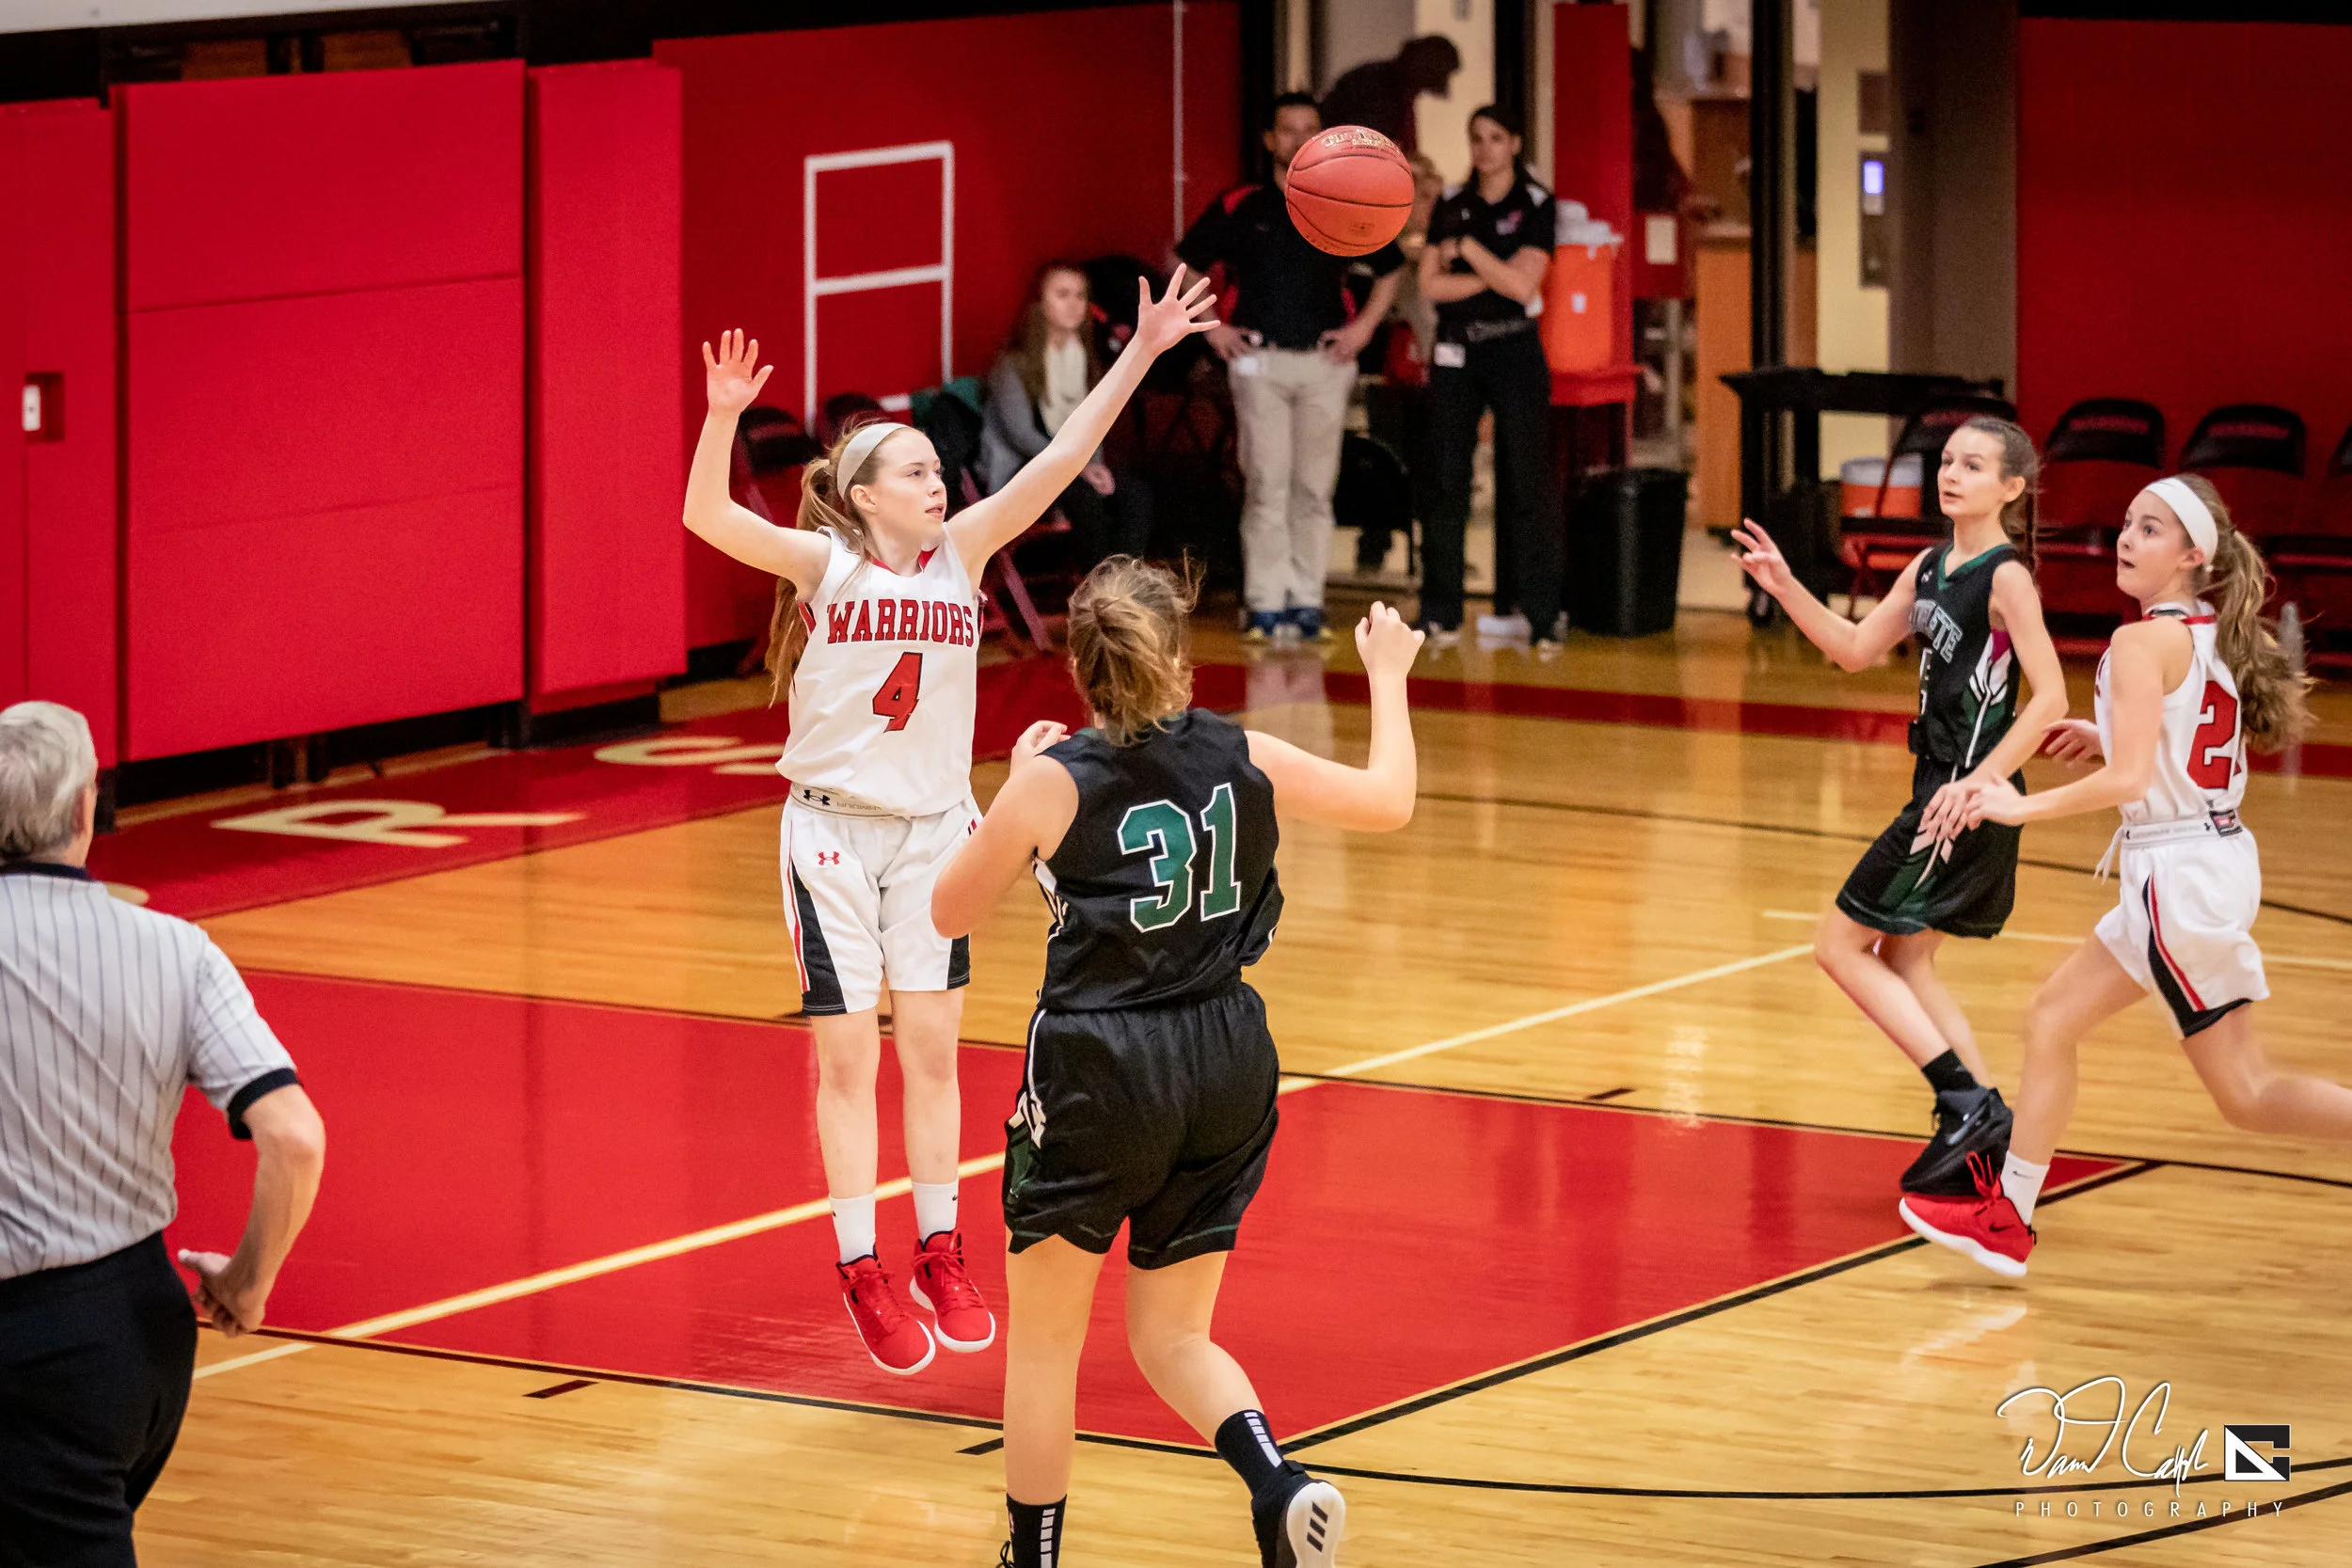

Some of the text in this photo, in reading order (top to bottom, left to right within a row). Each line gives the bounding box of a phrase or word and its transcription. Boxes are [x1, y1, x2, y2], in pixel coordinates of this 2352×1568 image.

[827, 598, 975, 648] WARRIORS
[872, 651, 924, 734] 4
[2186, 679, 2242, 791] 2
[1117, 782, 1242, 934] 31
